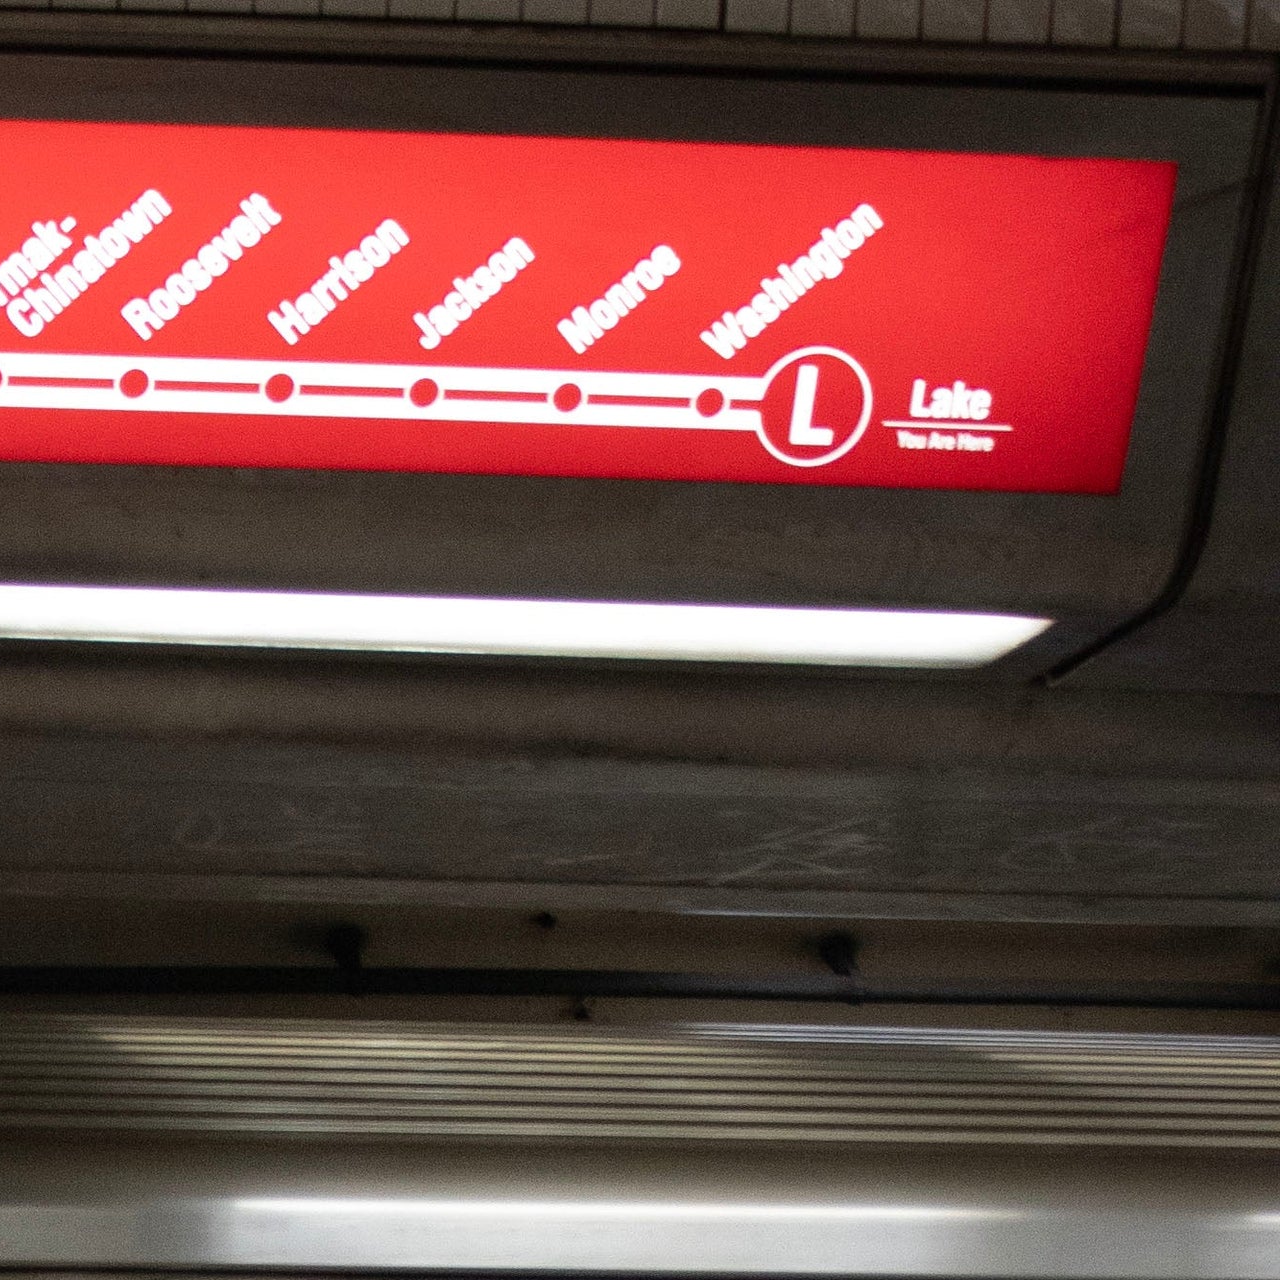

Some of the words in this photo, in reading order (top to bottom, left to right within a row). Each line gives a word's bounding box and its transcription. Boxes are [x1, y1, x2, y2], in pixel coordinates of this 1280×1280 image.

[6, 188, 173, 338] Chinatown
[120, 192, 283, 341] Roosevelt
[267, 218, 410, 346] Harrison
[413, 237, 536, 350] Jackson
[556, 244, 682, 355] Monroe
[699, 203, 884, 360] Washington
[909, 378, 993, 421] Lake
